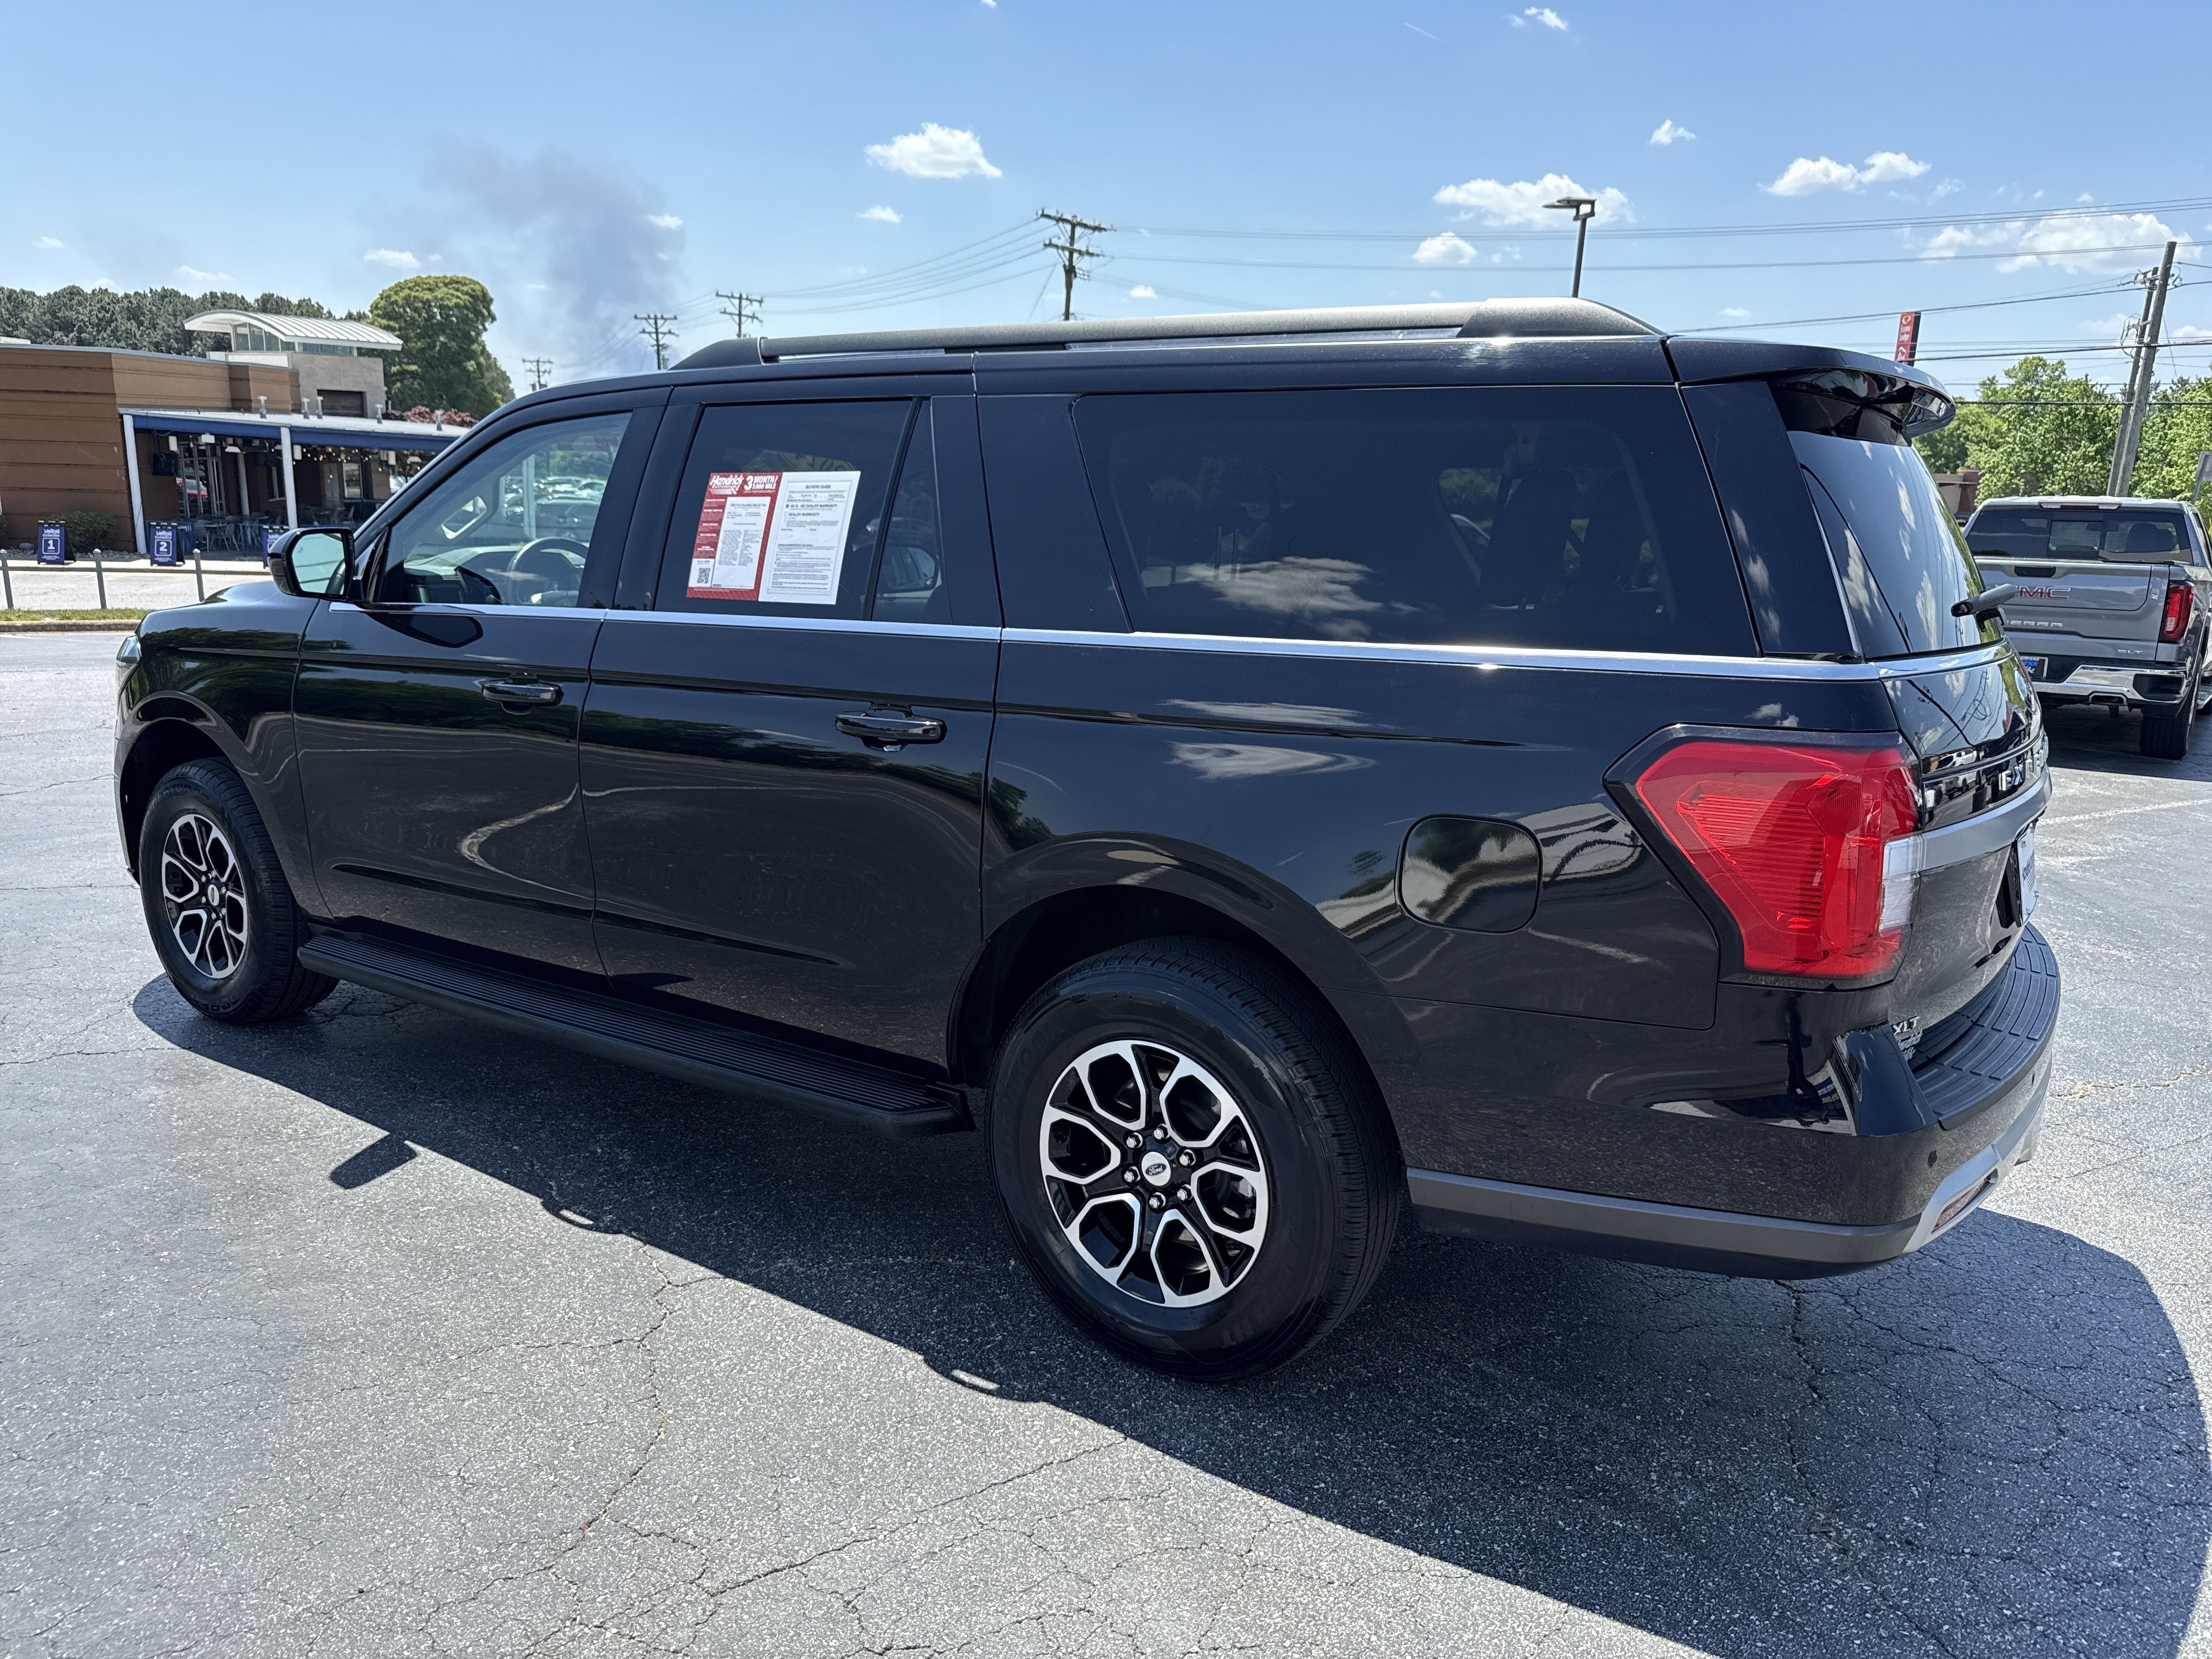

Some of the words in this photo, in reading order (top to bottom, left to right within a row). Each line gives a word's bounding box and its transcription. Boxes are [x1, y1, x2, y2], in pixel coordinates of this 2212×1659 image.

[744, 475, 754, 490] 3
[48, 539, 55, 550] 1
[159, 541, 168, 552] 2
[2013, 585, 2071, 600] MC
[2006, 619, 2063, 628] IERRA
[1893, 1016, 1920, 1036] XLT
[1149, 1165, 1164, 1175] Ford
